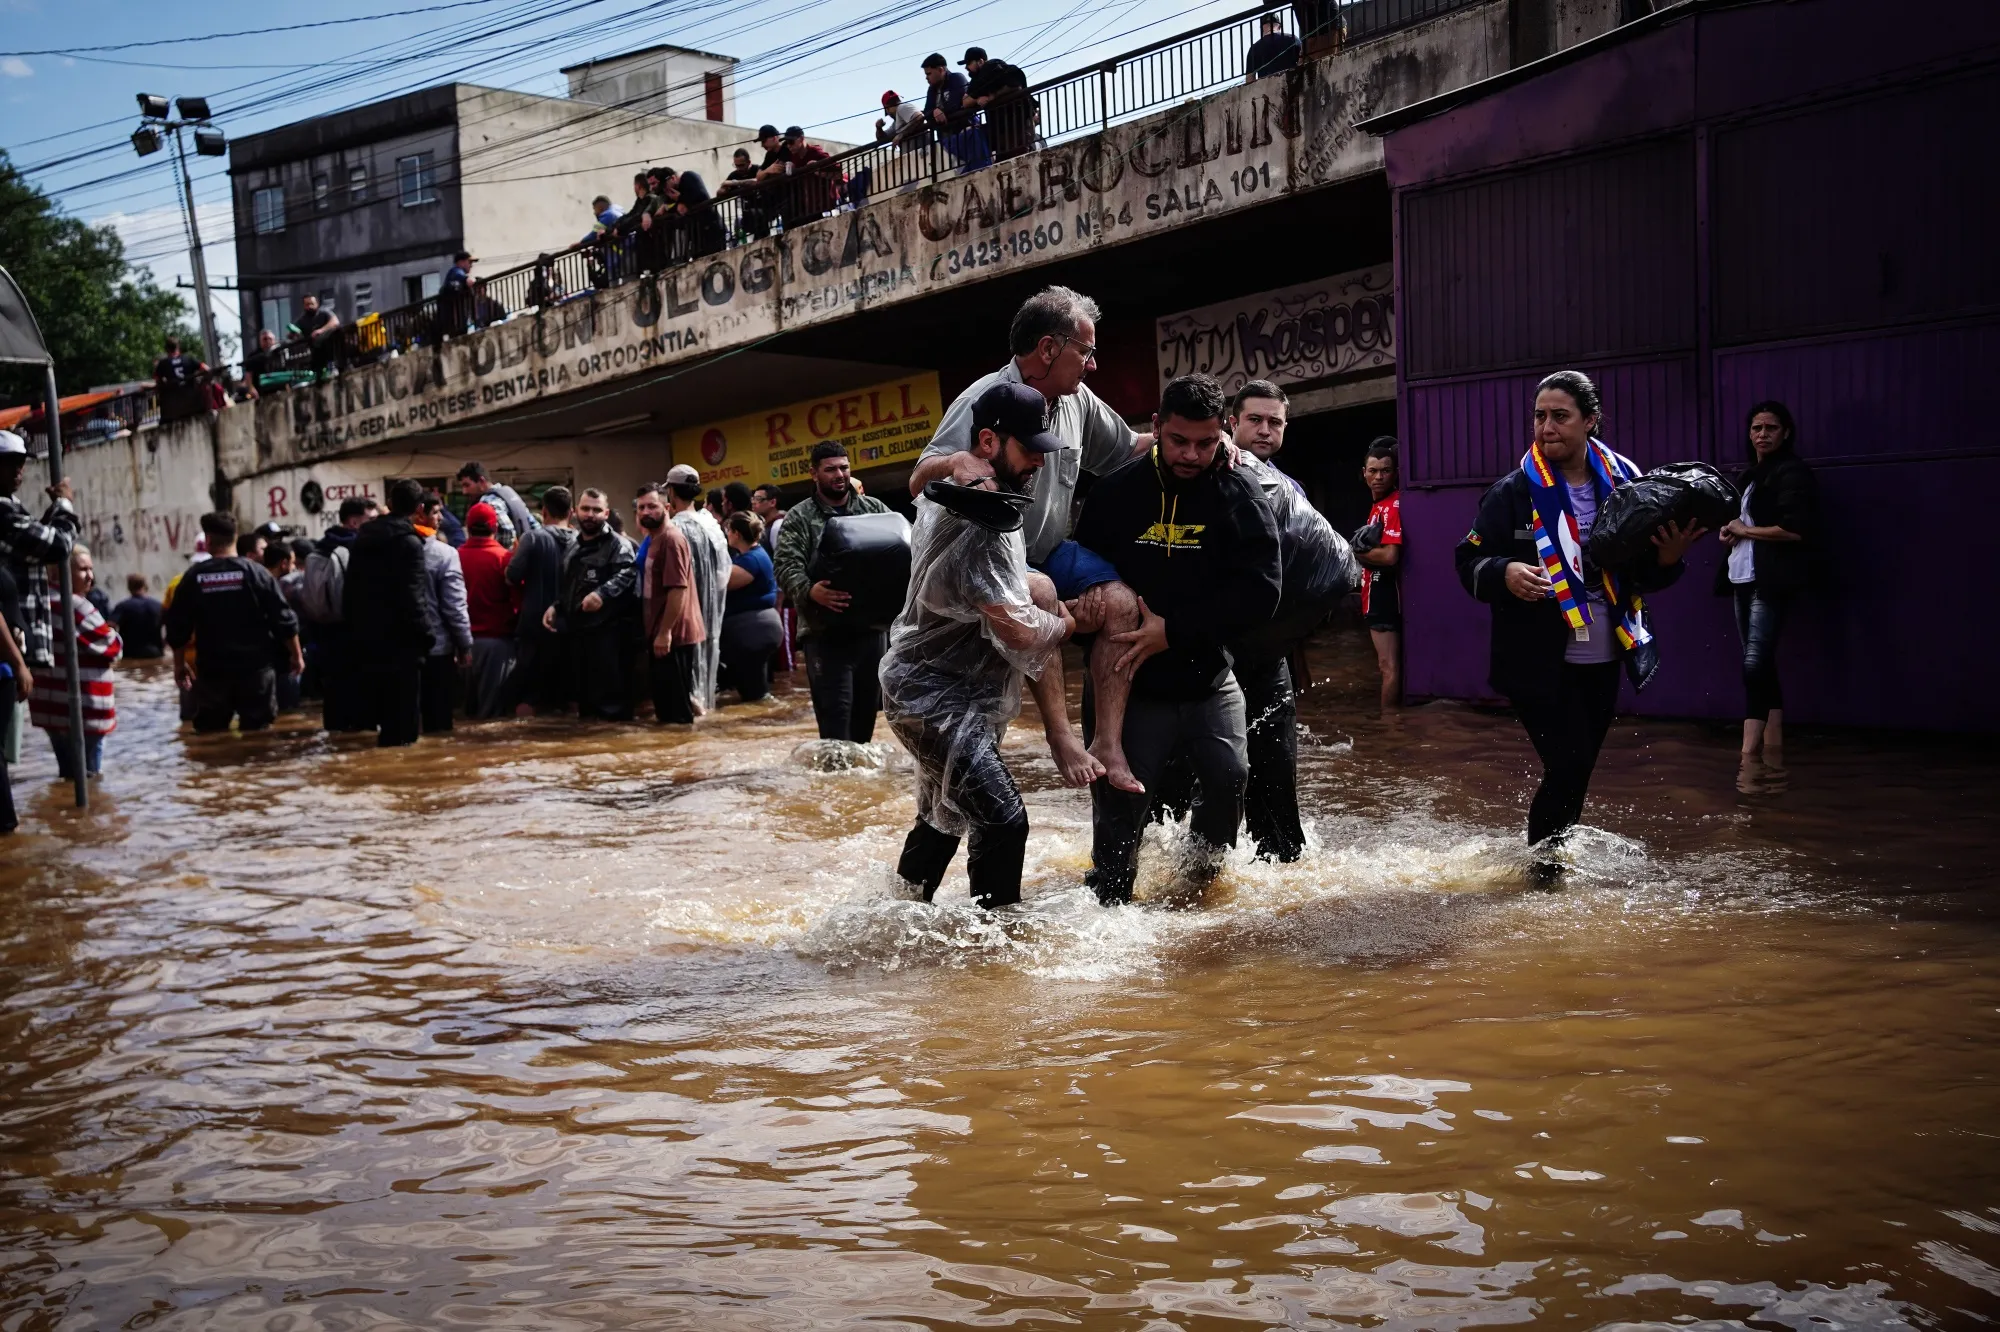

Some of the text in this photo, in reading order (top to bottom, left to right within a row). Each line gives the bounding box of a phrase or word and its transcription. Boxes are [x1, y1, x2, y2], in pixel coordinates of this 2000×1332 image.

[359, 414, 405, 437] GERAL
[578, 327, 699, 377] ORTODONTIA
[1145, 178, 1224, 220] SALA
[1230, 162, 1271, 196] 101
[765, 383, 930, 449] R CELL
[700, 465, 750, 484] BRATEL
[268, 483, 376, 518] R CELL
